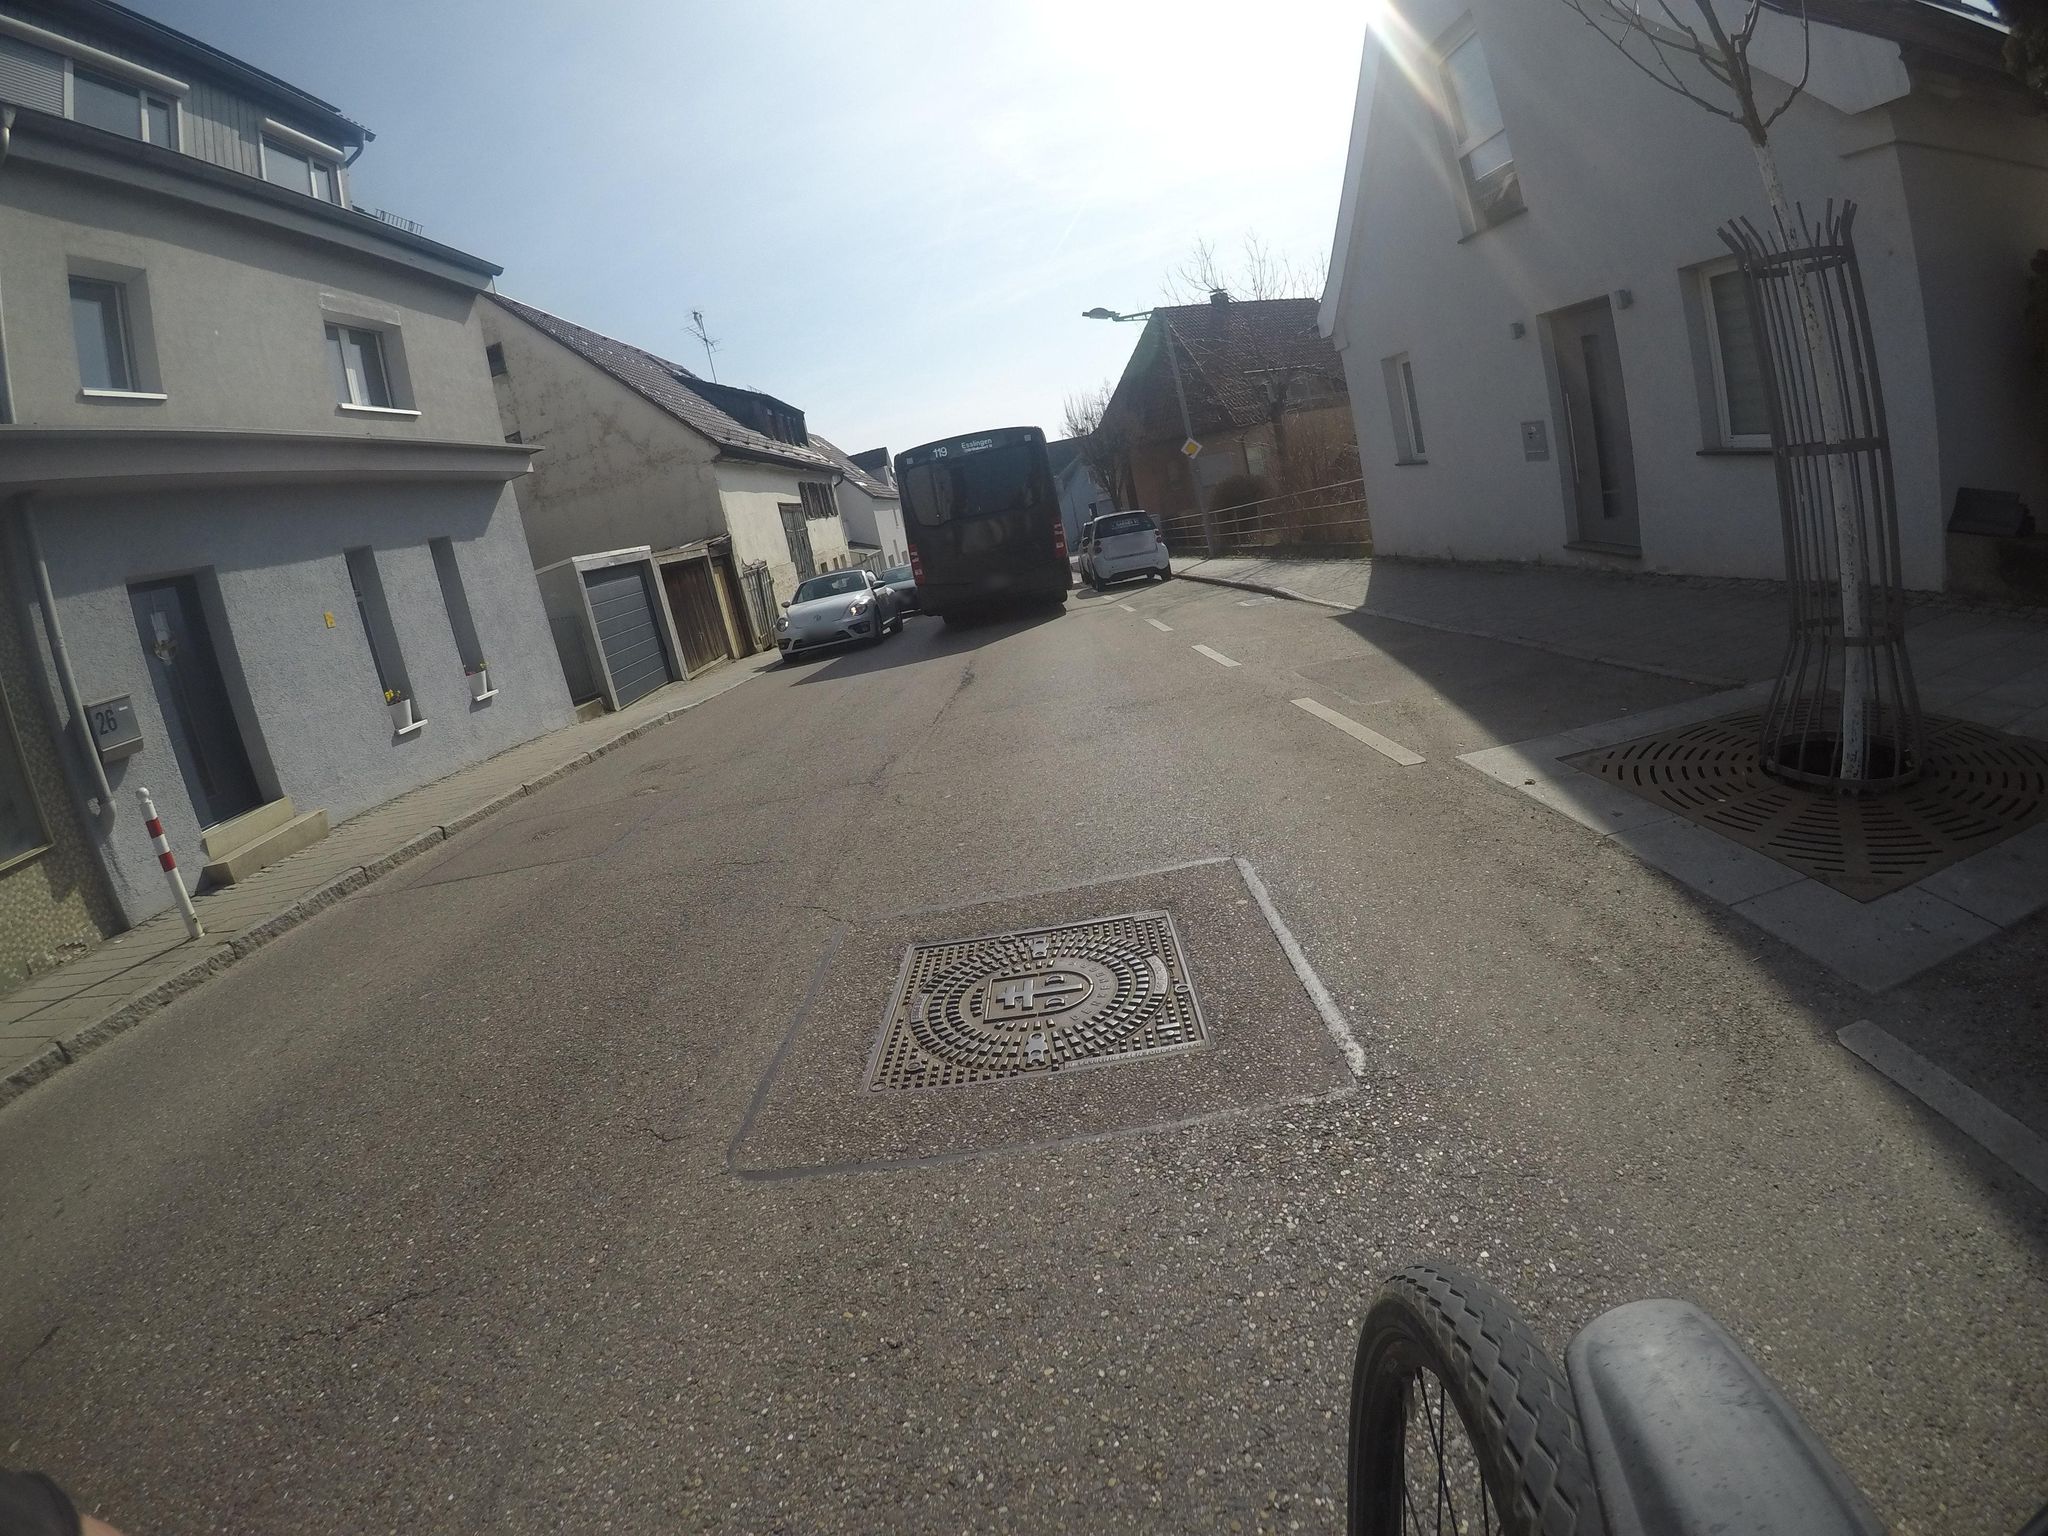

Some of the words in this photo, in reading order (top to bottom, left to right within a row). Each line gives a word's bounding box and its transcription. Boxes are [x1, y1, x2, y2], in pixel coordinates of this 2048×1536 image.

[961, 439, 992, 449] Esslingen
[933, 447, 948, 458] 119
[96, 709, 118, 735] 26
